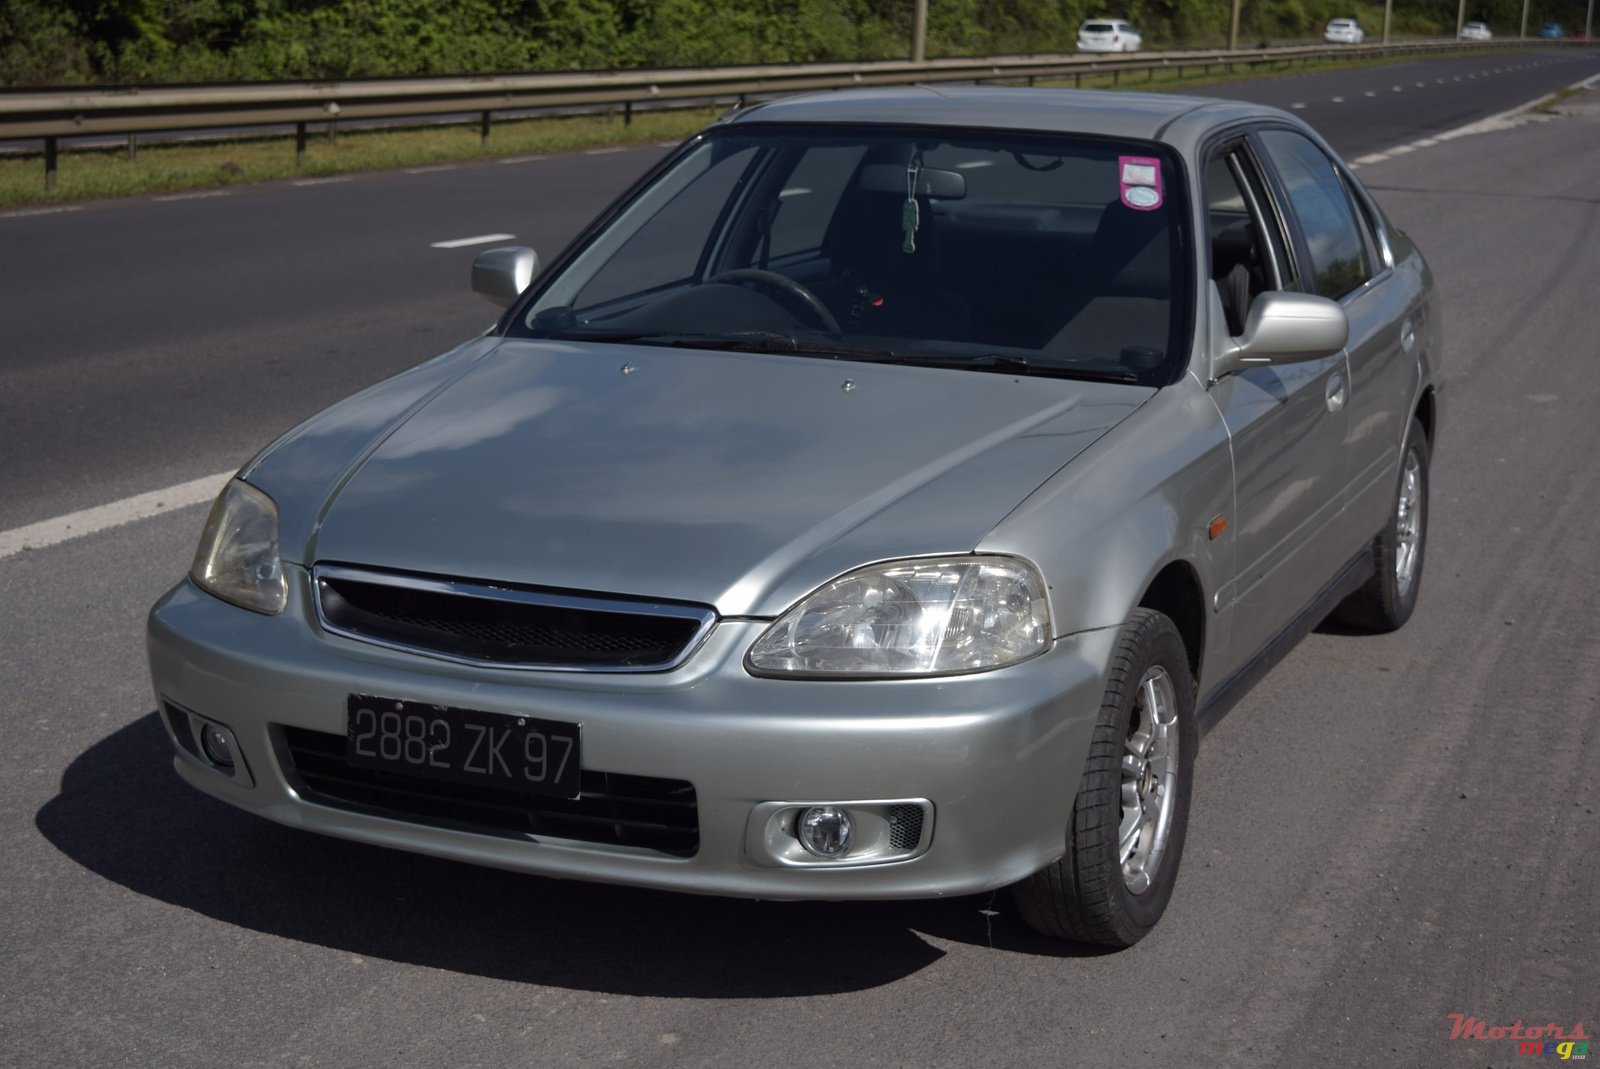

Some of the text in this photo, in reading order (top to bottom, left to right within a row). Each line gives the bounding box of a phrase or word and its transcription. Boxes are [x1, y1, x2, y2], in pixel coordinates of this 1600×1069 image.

[355, 708, 574, 784] 2882 ZK 97
